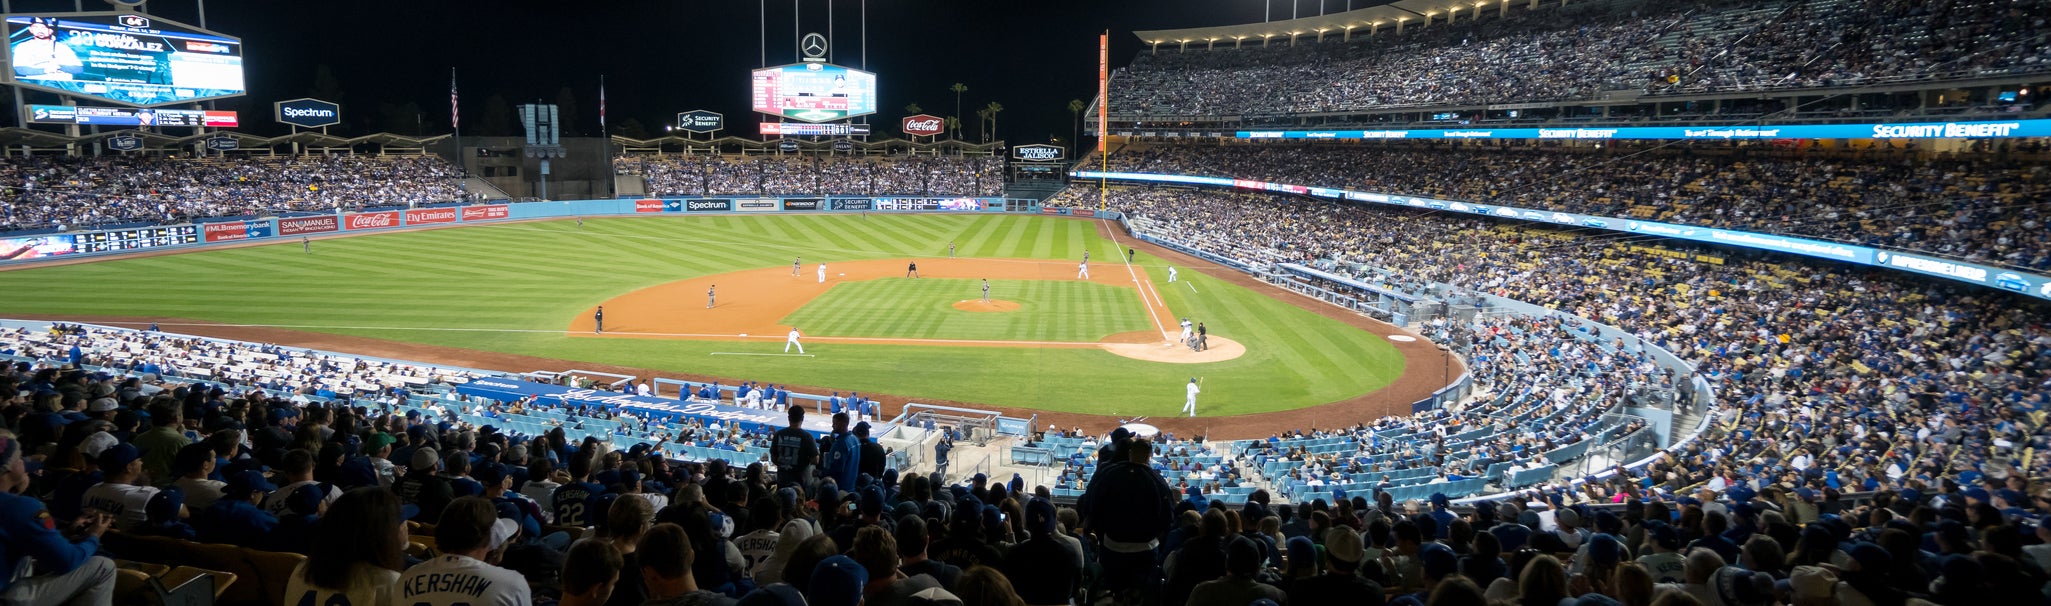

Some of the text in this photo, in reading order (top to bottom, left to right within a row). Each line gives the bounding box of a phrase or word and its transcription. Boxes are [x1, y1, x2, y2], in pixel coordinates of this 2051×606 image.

[284, 107, 332, 118] Spectrum
[1538, 129, 1577, 139] SECURITY
[1872, 124, 1945, 139] SECURITY
[1019, 147, 1059, 155] ESTRELLA
[688, 201, 726, 210] Spectrum
[407, 211, 456, 223] Fly Emirates
[205, 221, 271, 233] #MLBmemorybank
[281, 218, 335, 229] SAN MANUEL
[559, 501, 585, 528] 22
[403, 573, 492, 599] KERSHAW
